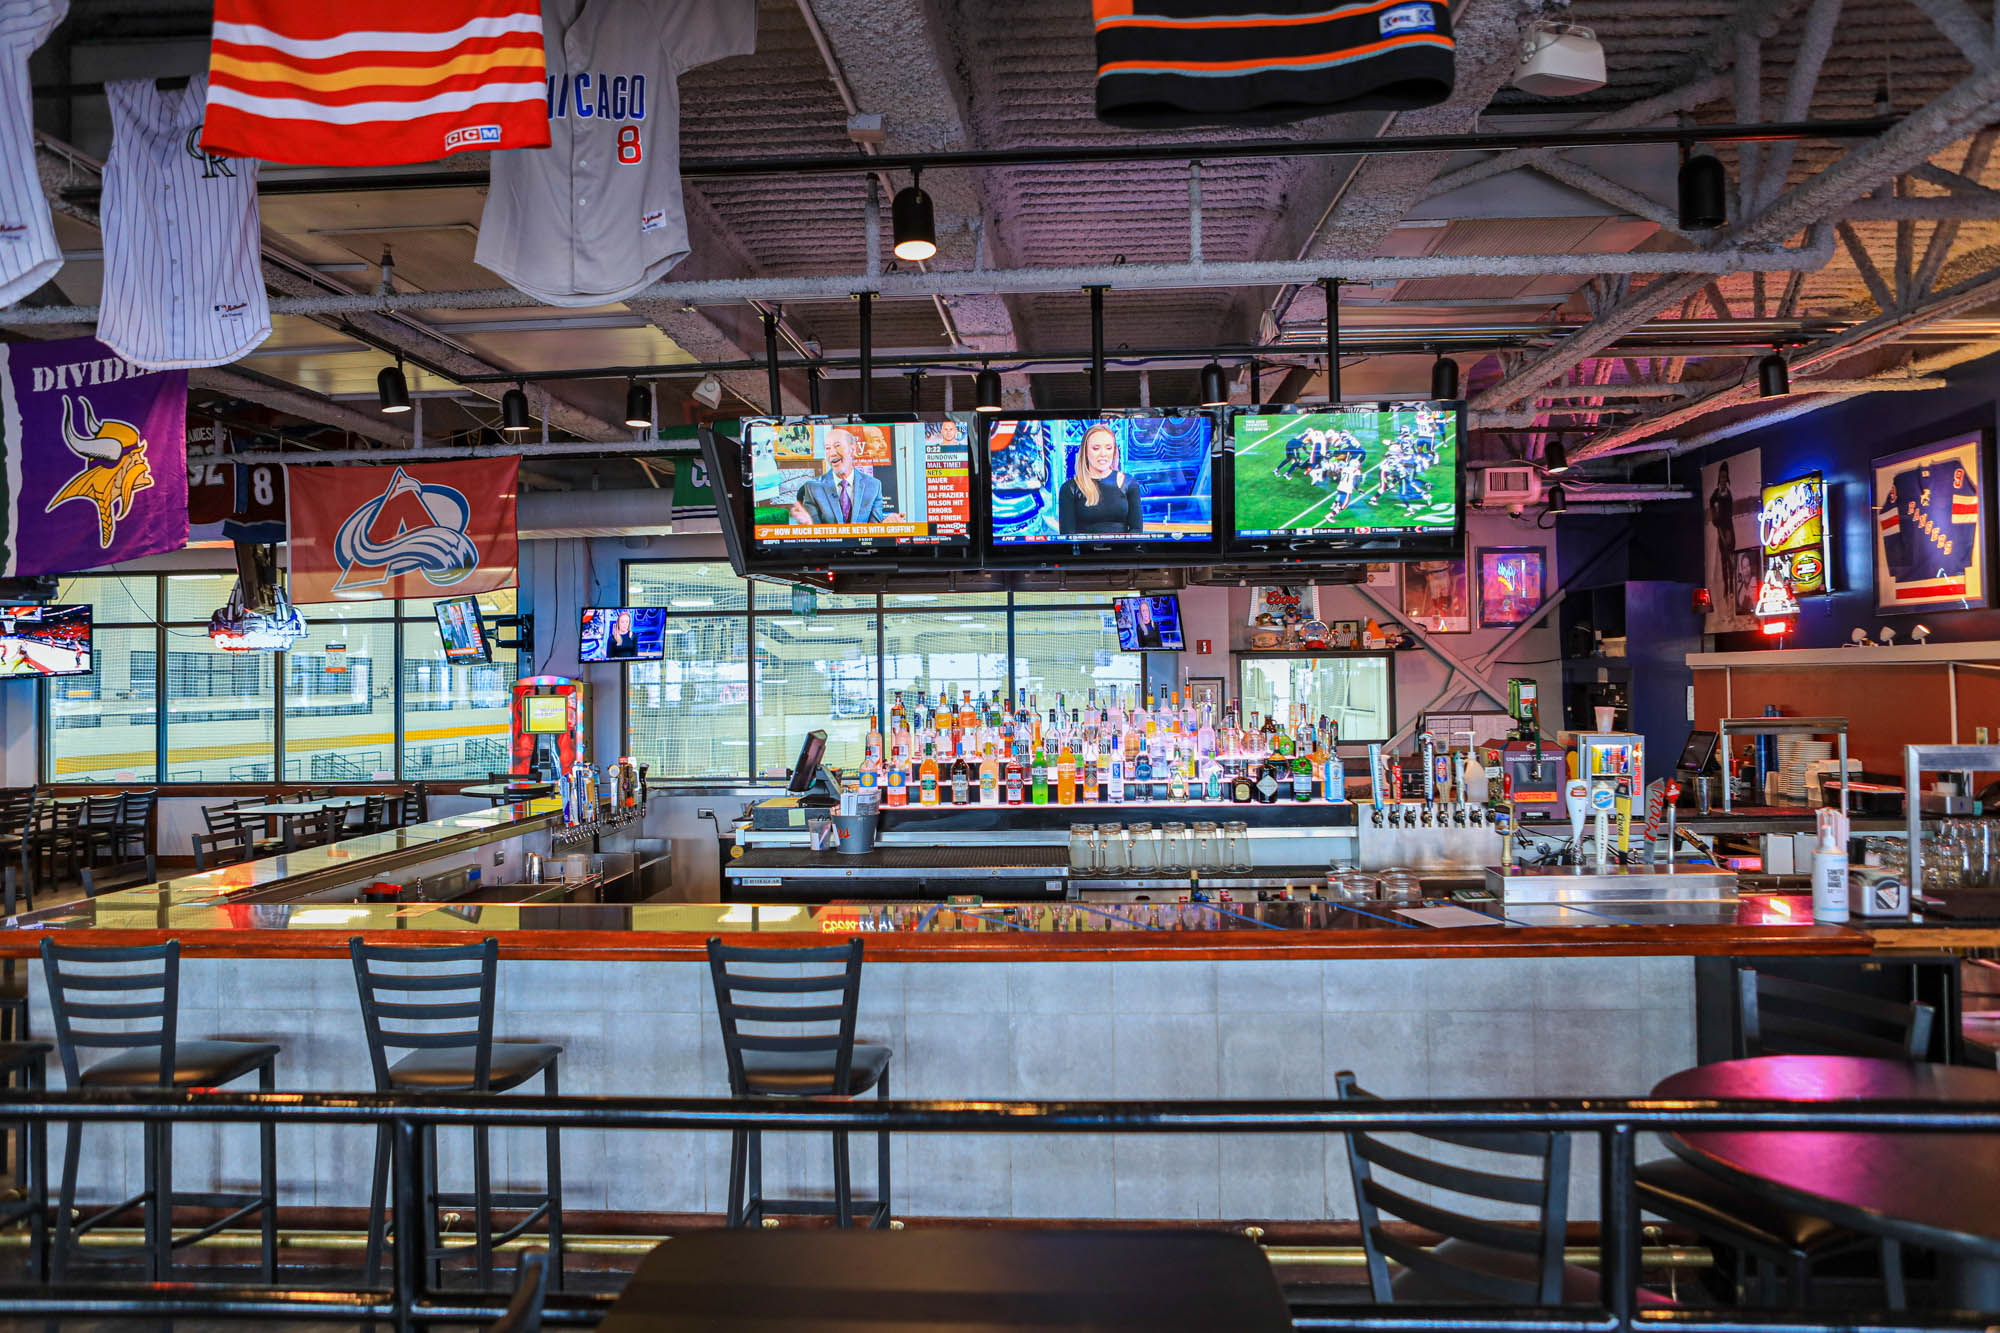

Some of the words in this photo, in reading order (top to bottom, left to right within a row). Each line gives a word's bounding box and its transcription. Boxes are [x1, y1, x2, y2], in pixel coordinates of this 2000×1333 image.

[447, 128, 500, 144] CCM
[617, 125, 642, 165] 8
[32, 356, 160, 392] DIVID
[253, 467, 274, 506] 8
[1953, 468, 1965, 489] 9
[792, 527, 812, 535] MUCH
[814, 527, 836, 535] BETTER
[838, 526, 850, 534] ARE
[852, 526, 868, 534] NETS
[869, 525, 885, 534] WITH
[886, 525, 915, 533] GRIFFIN?
[1907, 501, 1953, 555] RANGERS
[1266, 590, 1300, 605] Coors
[1046, 743, 1058, 754] SON
[1070, 743, 1082, 754] SON
[1098, 743, 1111, 754] SON
[1644, 789, 1664, 842] Coors
